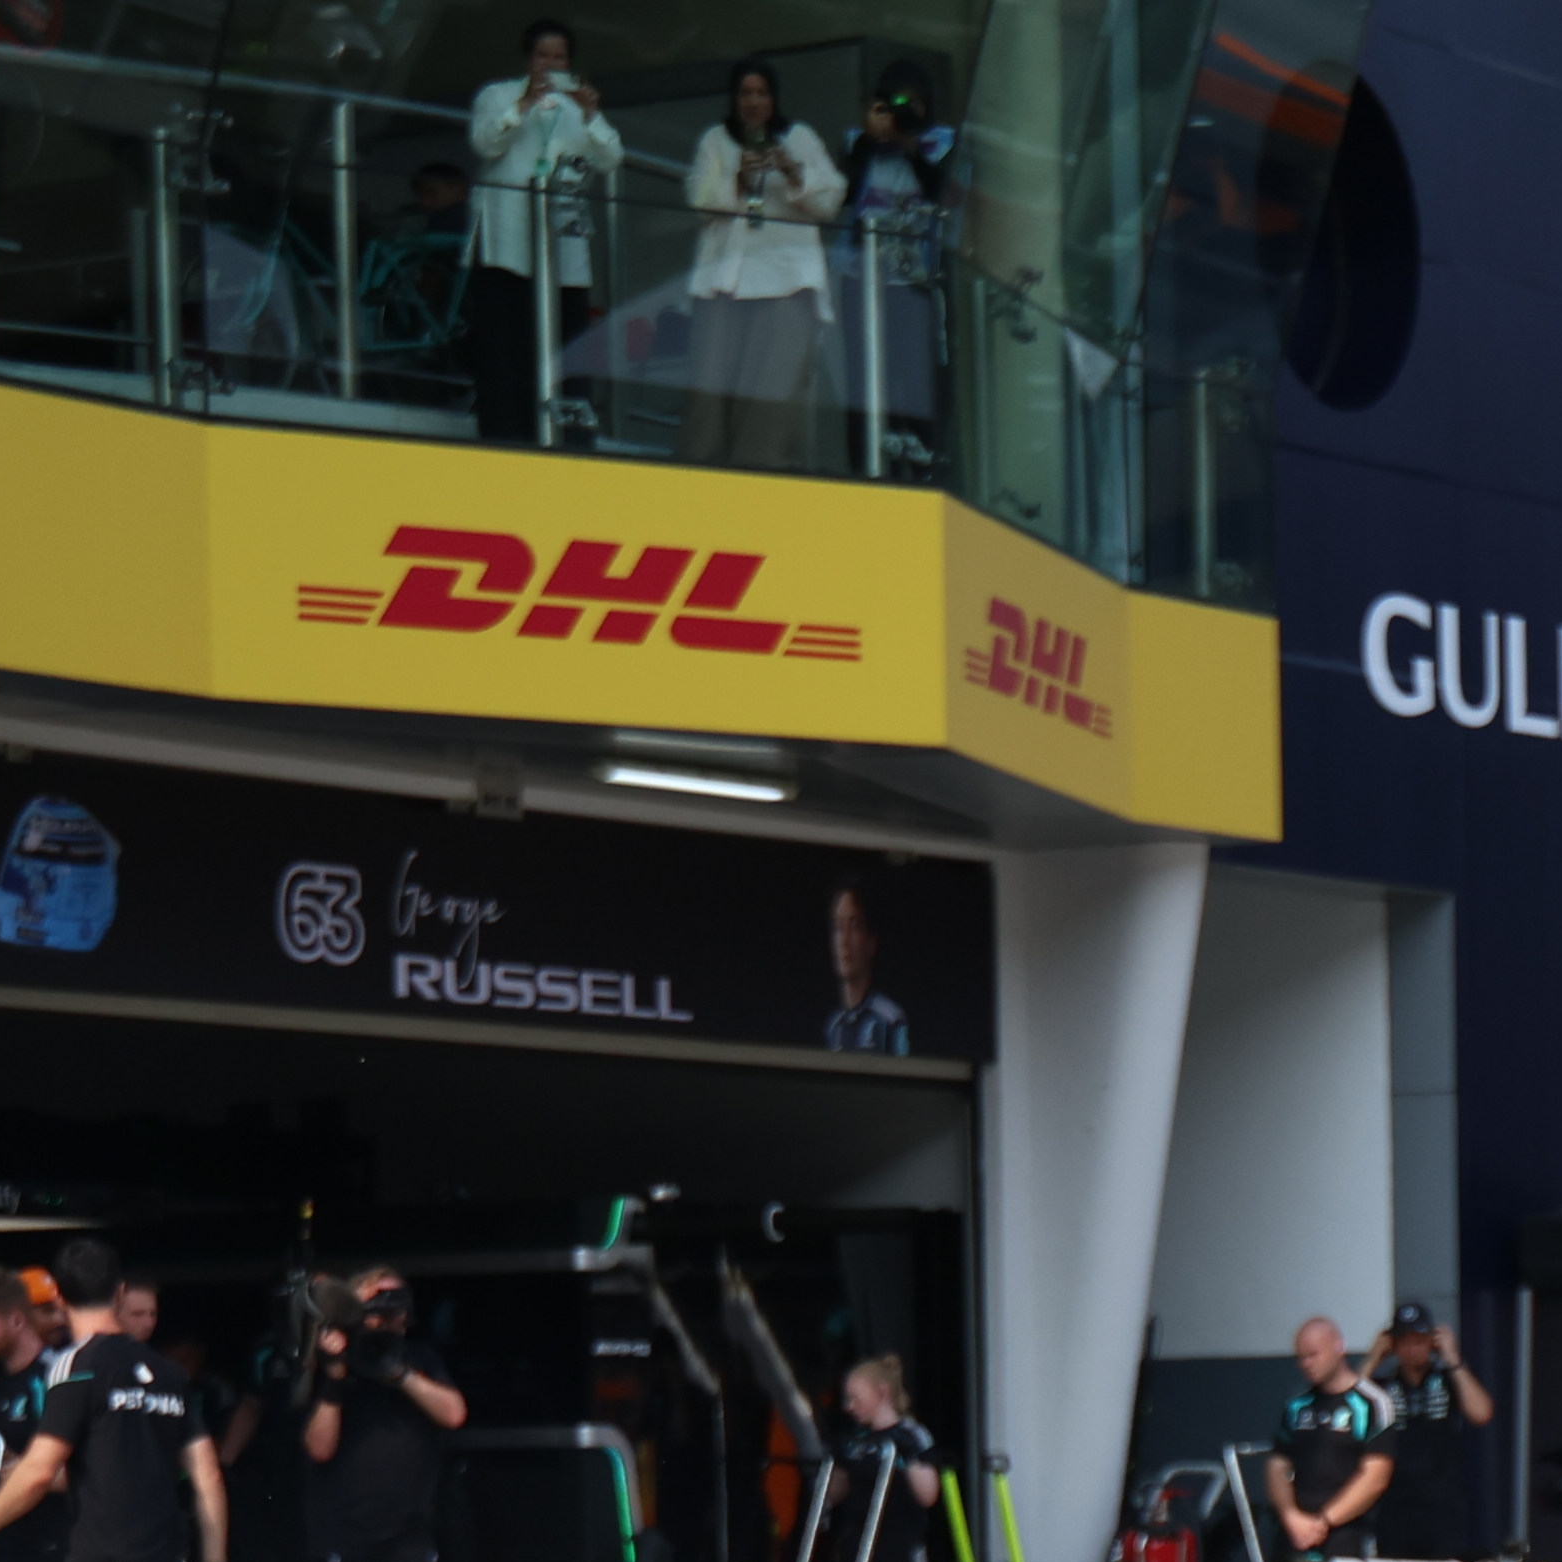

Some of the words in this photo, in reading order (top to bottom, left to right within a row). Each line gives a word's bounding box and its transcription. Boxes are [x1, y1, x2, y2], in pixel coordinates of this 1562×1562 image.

[378, 525, 789, 654] DHL
[984, 597, 1095, 727] DHL
[277, 861, 365, 966] 63
[390, 848, 507, 990] George
[393, 953, 694, 1023] RUSSELL
